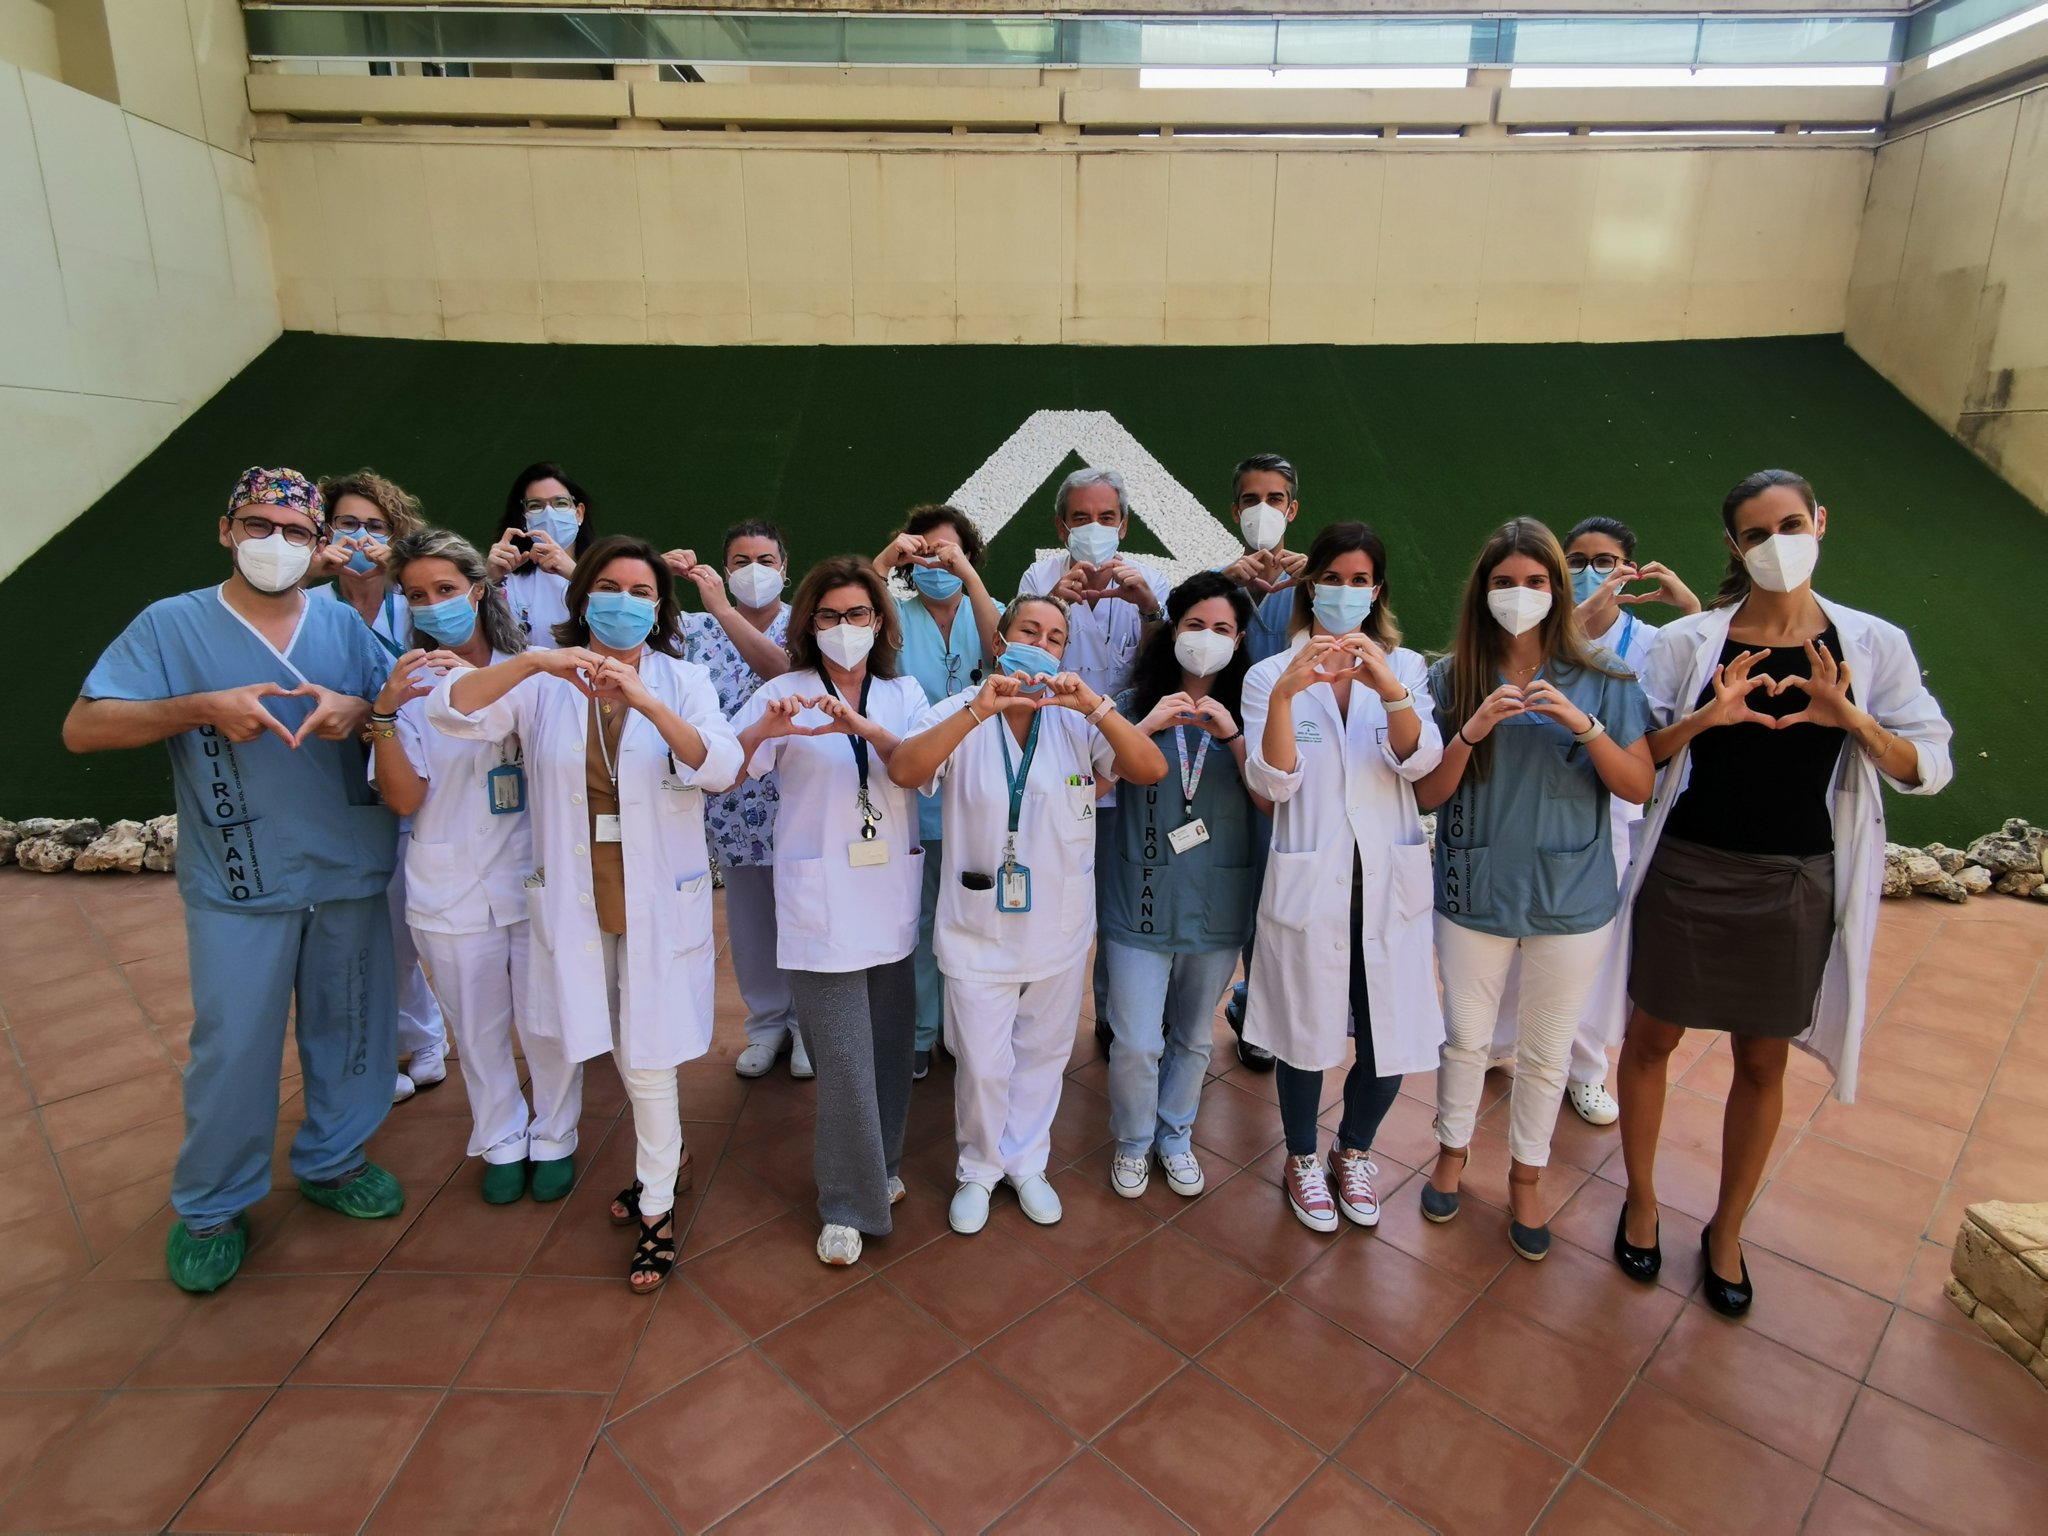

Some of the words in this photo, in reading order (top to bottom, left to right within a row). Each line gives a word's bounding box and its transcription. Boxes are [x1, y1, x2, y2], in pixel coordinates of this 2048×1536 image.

[253, 867, 264, 893] AGENCIA
[1141, 782, 1158, 934] UIRÓFANO
[1446, 786, 1464, 914] IRÓFANO
